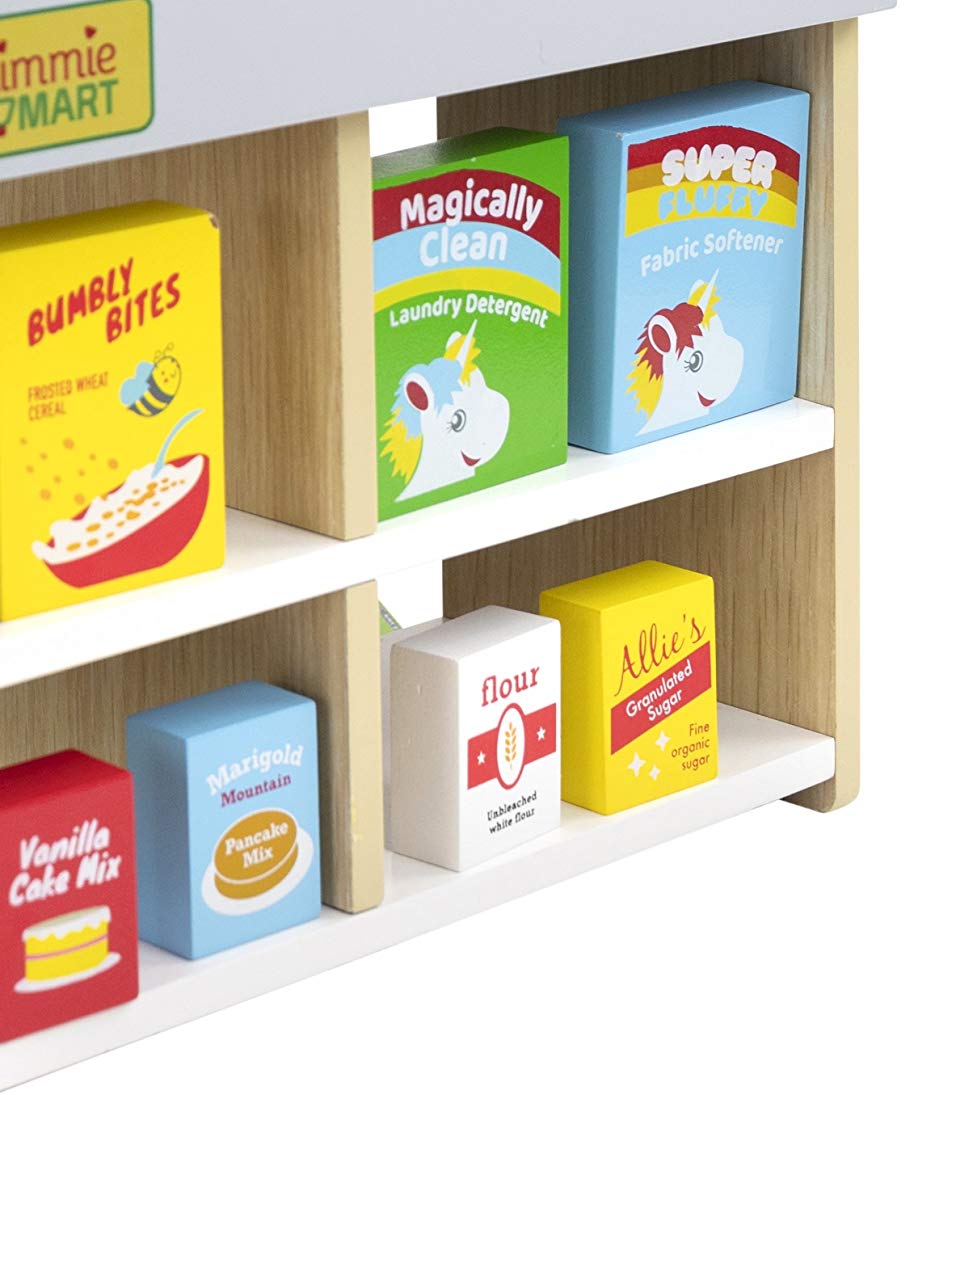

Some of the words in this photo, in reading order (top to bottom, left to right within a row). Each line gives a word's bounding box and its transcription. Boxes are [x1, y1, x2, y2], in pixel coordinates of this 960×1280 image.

[19, 79, 119, 131] MART
[661, 143, 777, 189] SUPER
[400, 177, 544, 232] Magically
[657, 184, 769, 221] FLUFFY
[419, 226, 508, 267] Clean
[640, 236, 700, 278] Fabric
[703, 228, 783, 255] Softener
[27, 256, 134, 347] BUMBLY
[106, 272, 180, 343] BITES
[390, 295, 462, 328] Laundry
[465, 293, 549, 329] Detergent
[27, 379, 73, 403] FROSTED
[76, 371, 109, 393] WHEAT
[28, 402, 66, 421] CEREAL
[614, 613, 706, 697] Allie's
[481, 666, 540, 707] flour
[625, 659, 693, 718] Granulated
[647, 688, 683, 721] Sugar
[671, 736, 710, 758] organic
[689, 722, 710, 737] Fine
[206, 743, 304, 796] Marigold
[681, 754, 710, 771] sugar
[220, 773, 292, 808] Mountain
[486, 790, 537, 822] Unbleached
[224, 821, 289, 856] Pancake
[489, 816, 512, 835] white
[515, 807, 535, 825] flour
[20, 818, 110, 870] Vanilla
[242, 846, 274, 868] Mix
[8, 862, 71, 907] Cake
[75, 851, 122, 889] Mix
